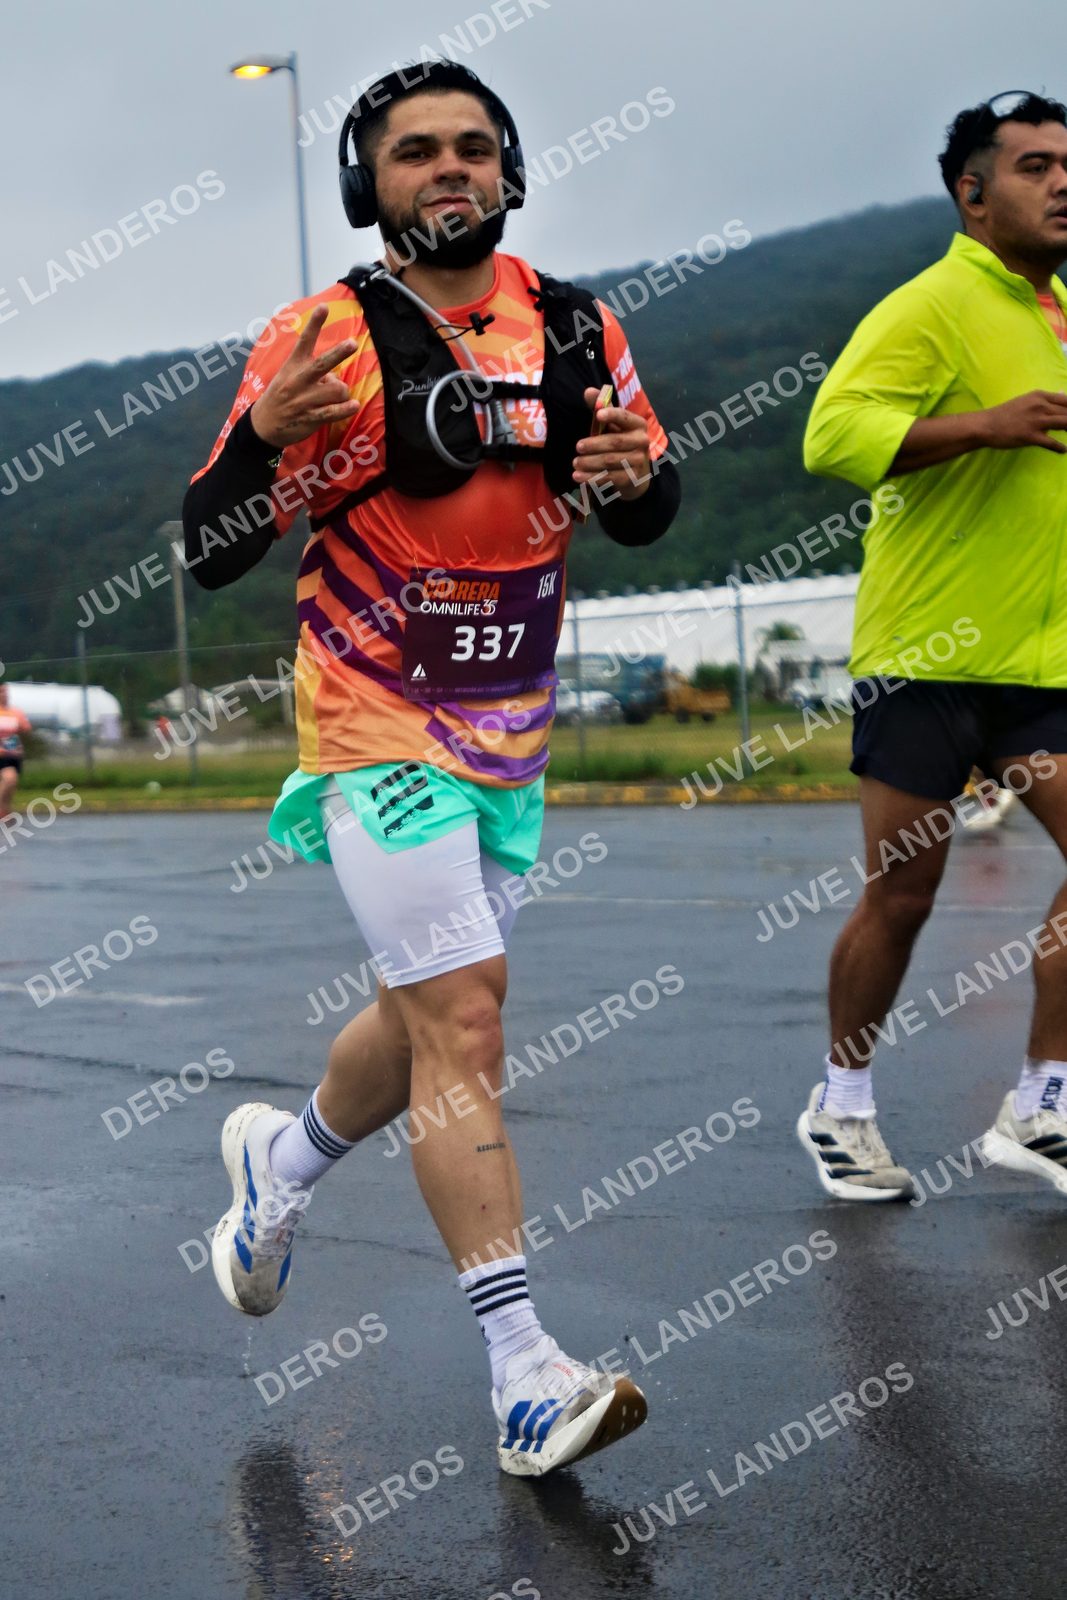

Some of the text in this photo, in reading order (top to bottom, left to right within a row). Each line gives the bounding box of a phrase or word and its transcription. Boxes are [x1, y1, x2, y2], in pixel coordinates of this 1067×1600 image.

[537, 570, 557, 599] 15K
[420, 600, 480, 616] OMNILIFE
[451, 622, 525, 661] 337
